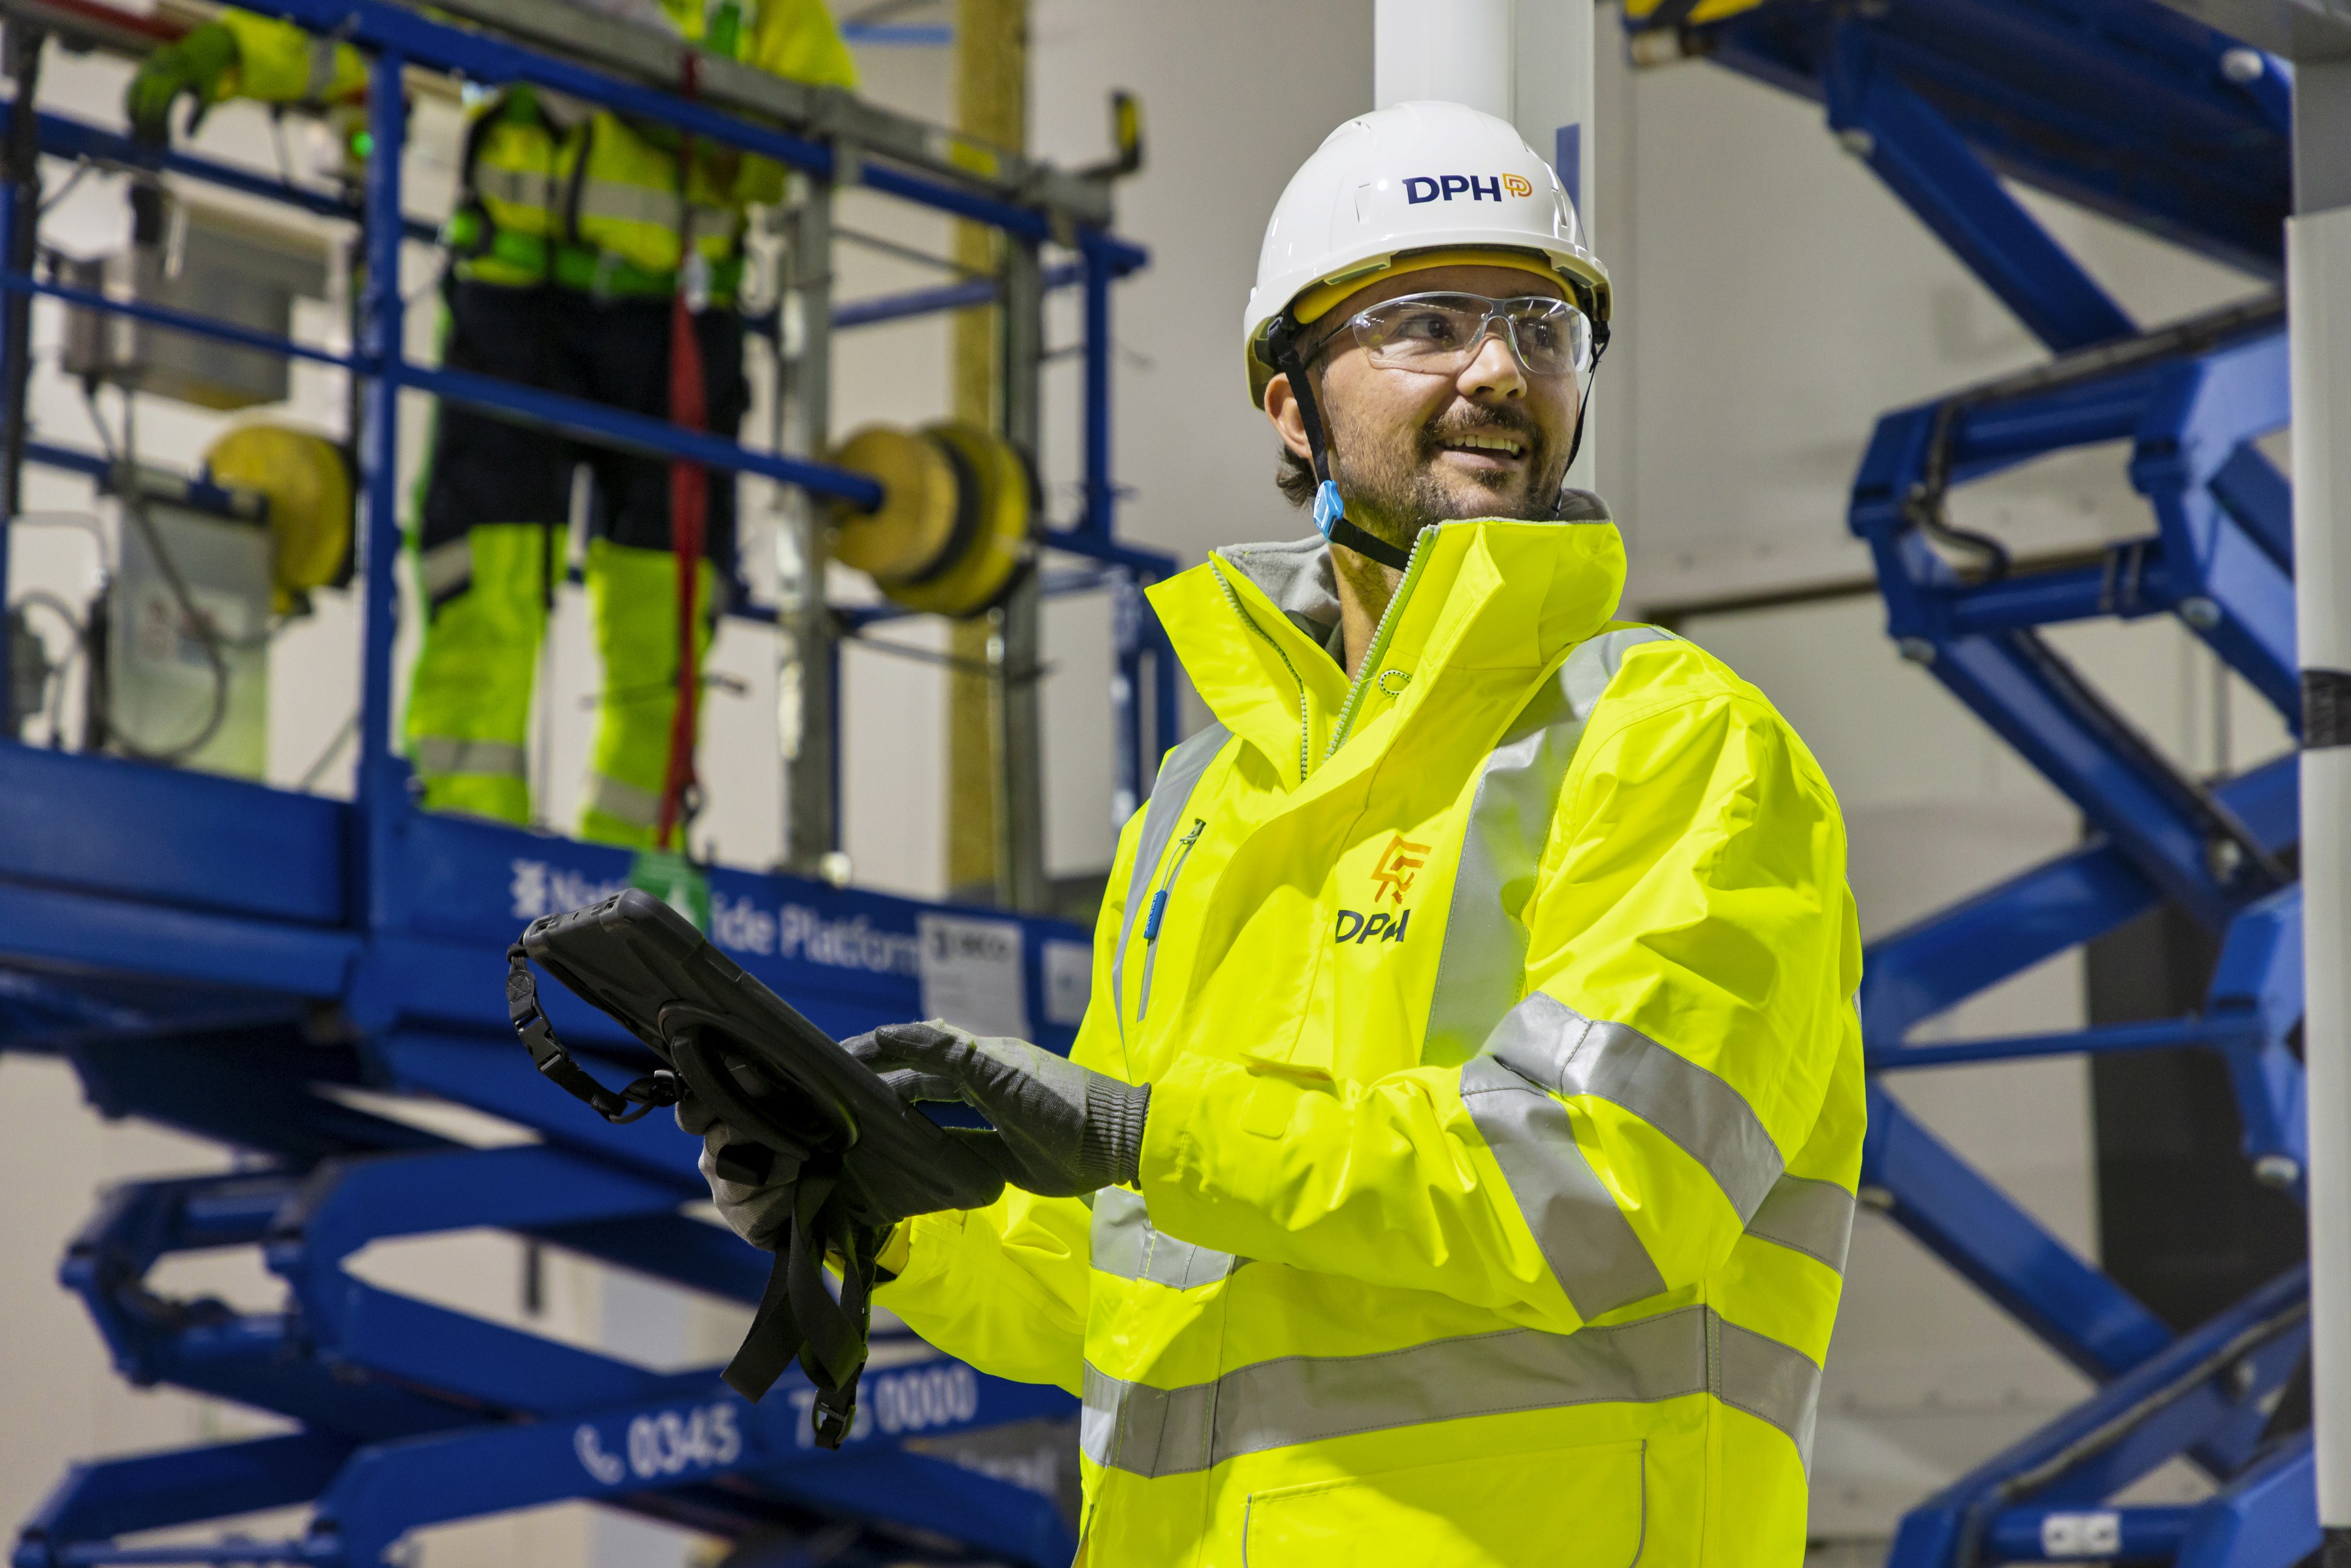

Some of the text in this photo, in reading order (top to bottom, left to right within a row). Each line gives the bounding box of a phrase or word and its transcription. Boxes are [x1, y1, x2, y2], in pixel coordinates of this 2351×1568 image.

[1402, 174, 1502, 204] DPH
[1335, 908, 1411, 944] DPH
[626, 1402, 742, 1479] 0345
[874, 1364, 978, 1435] 0000
